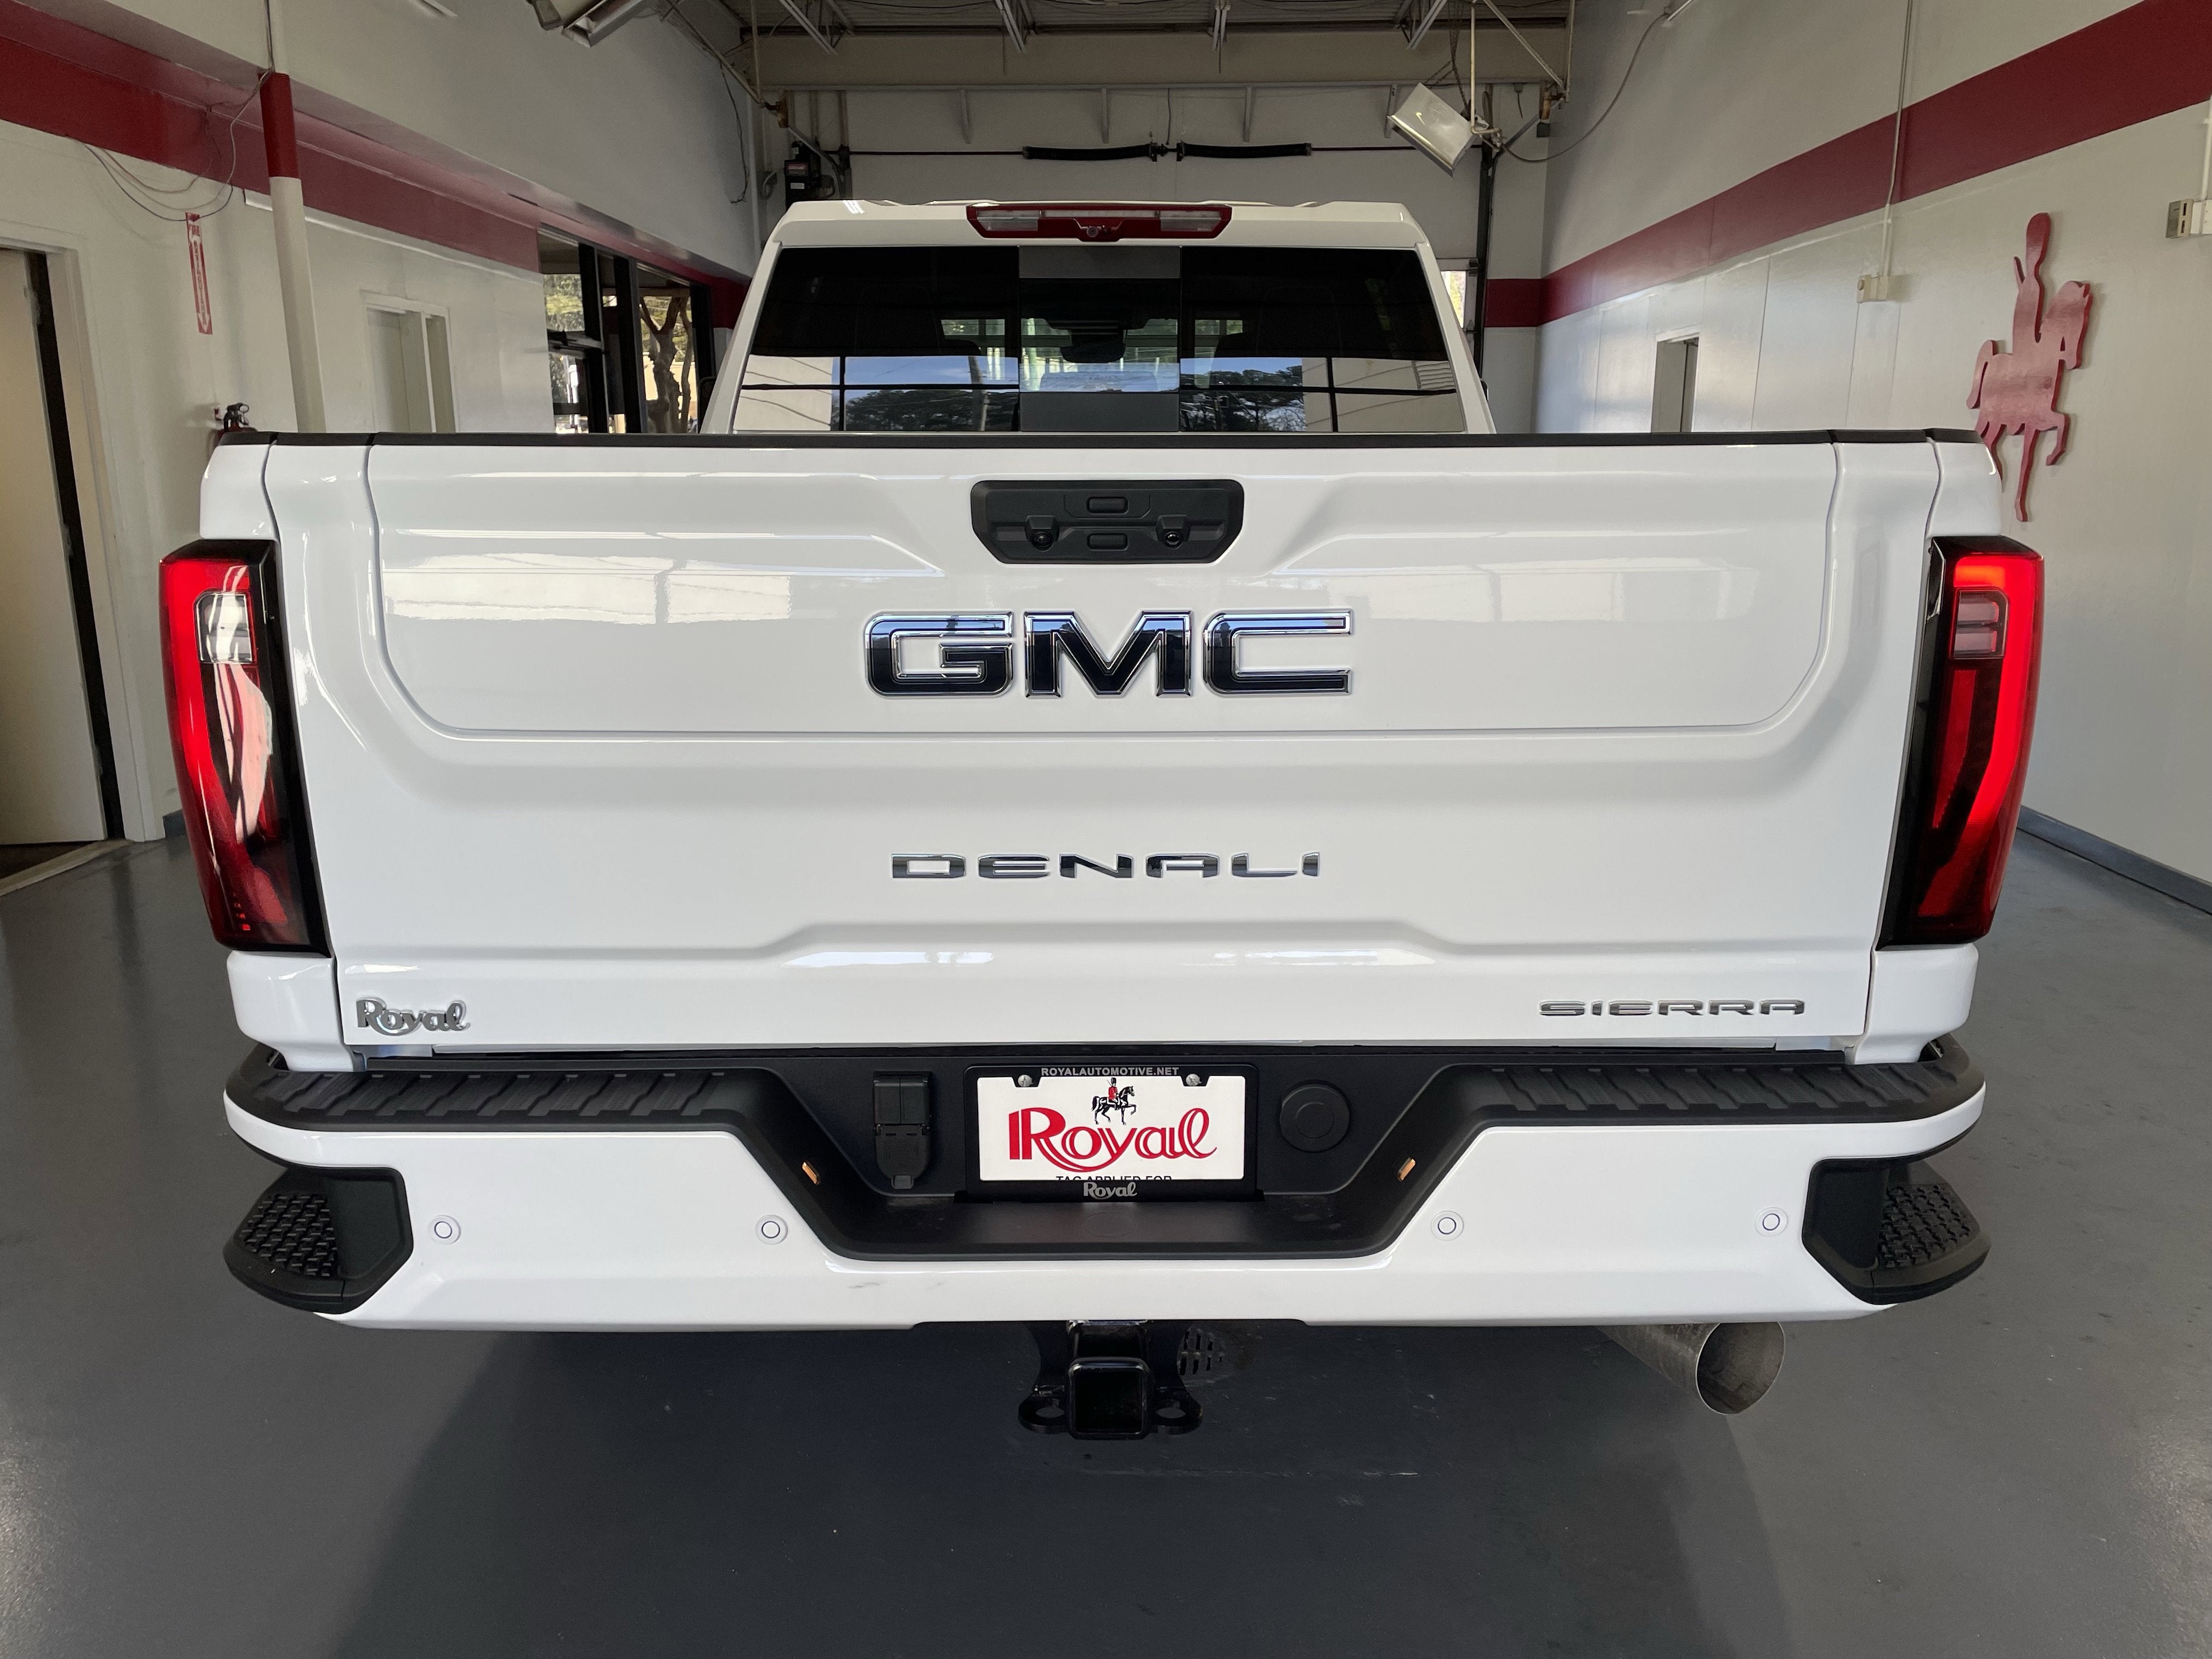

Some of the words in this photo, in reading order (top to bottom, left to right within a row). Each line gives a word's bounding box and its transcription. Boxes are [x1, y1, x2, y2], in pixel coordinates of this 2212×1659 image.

[865, 610, 1353, 698] GMC
[891, 853, 1321, 878] DENALI
[356, 996, 470, 1036] Royal
[1539, 999, 1805, 1016] SIERRA
[1041, 1067, 1180, 1076] ROYALAUTOMOTIVE.NET
[1008, 1107, 1217, 1172] Royal
[1084, 1182, 1137, 1200] Royal
